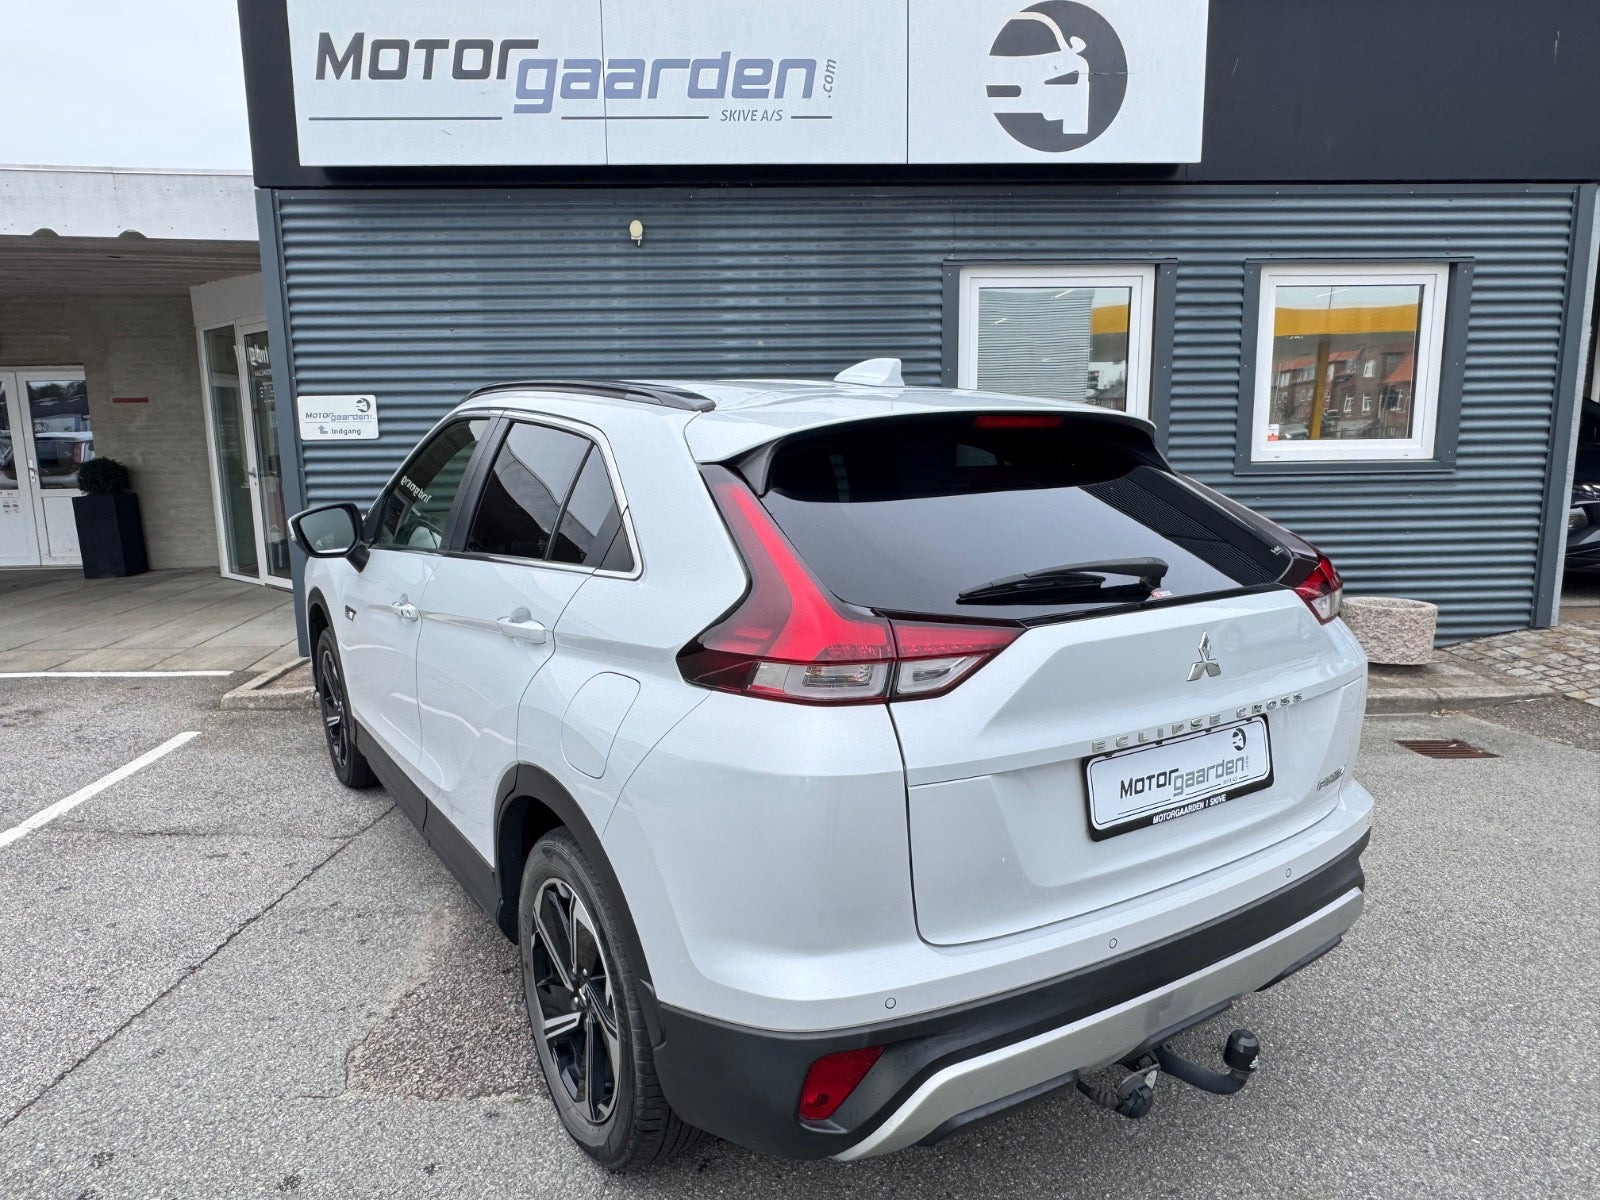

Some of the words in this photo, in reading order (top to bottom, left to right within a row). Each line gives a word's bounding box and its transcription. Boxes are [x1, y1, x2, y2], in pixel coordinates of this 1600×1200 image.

[822, 58, 837, 99] .com
[720, 109, 758, 122] SKIVE
[761, 109, 784, 122] A/S
[331, 428, 362, 436] Indgang
[1092, 714, 1221, 753] ECLIPSE
[1236, 692, 1303, 718] CROSS
[1152, 801, 1204, 824] MOTORGAARDEN
